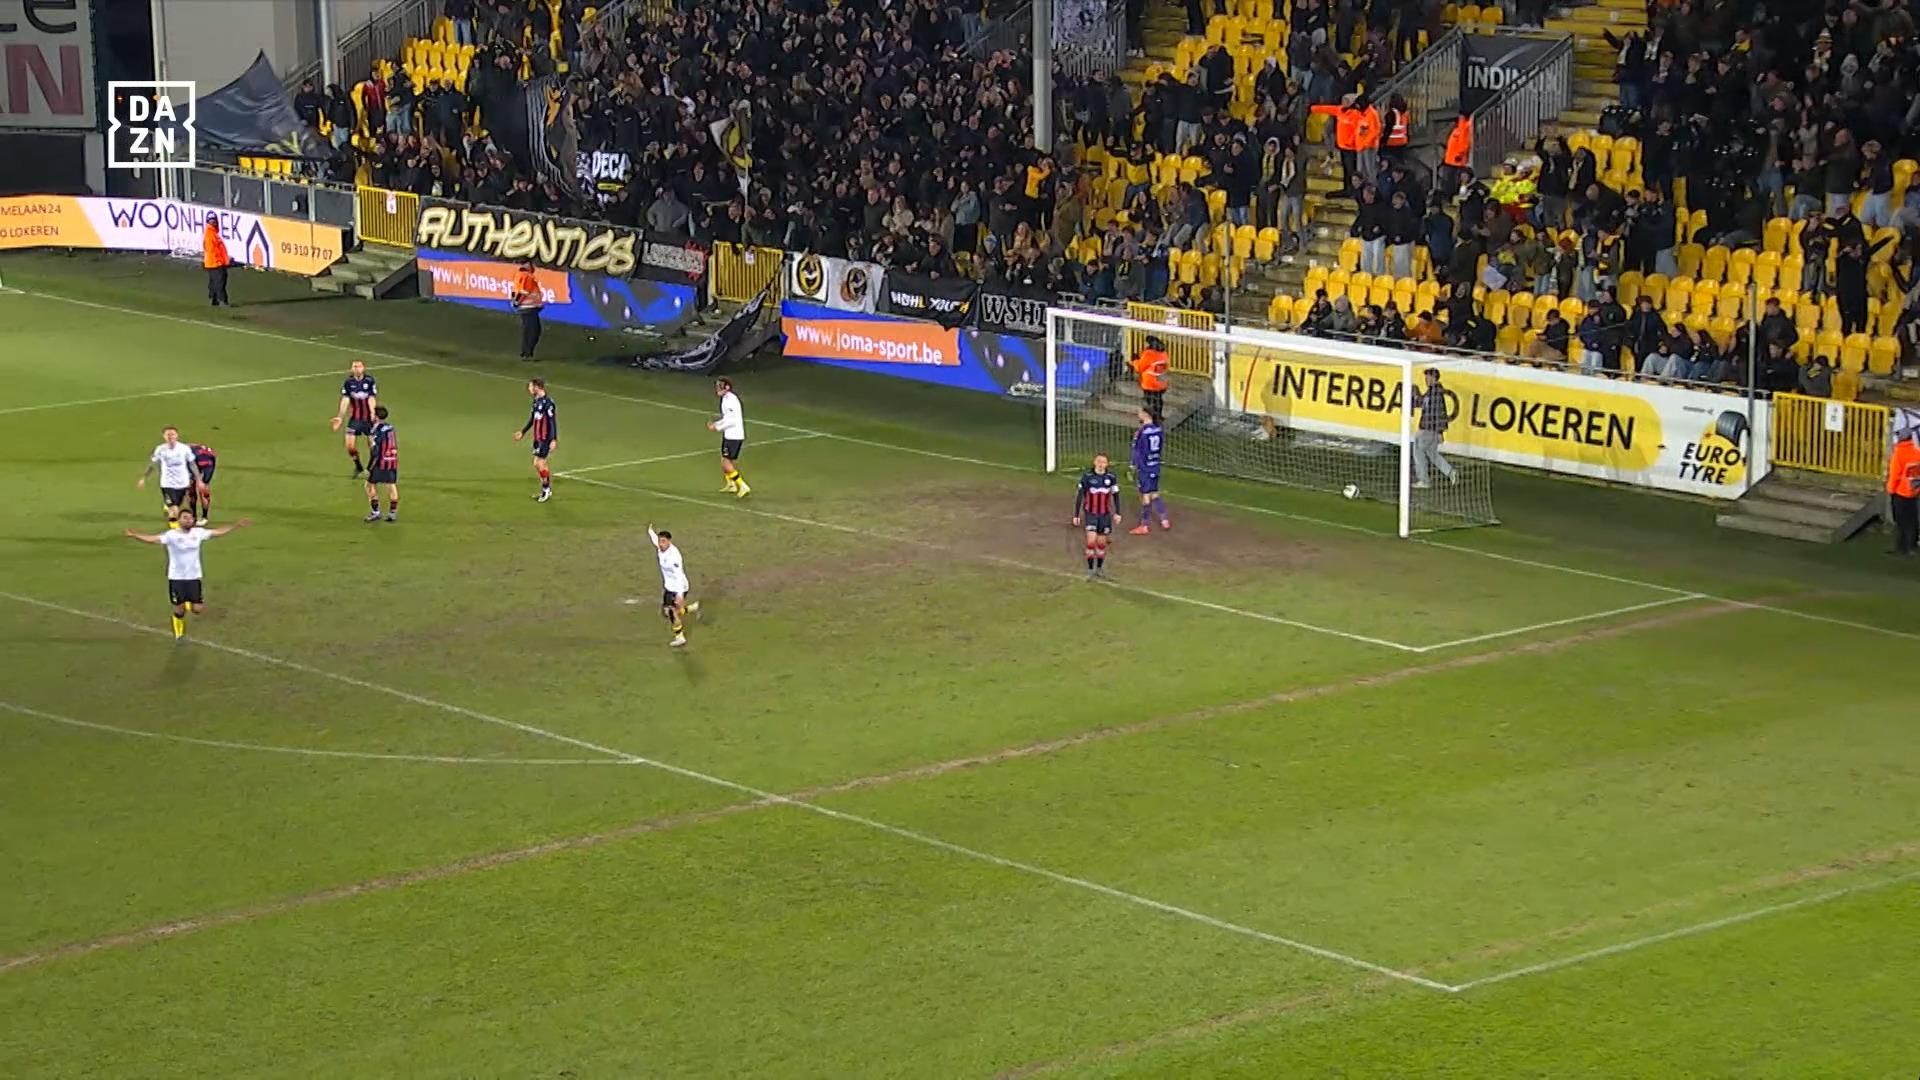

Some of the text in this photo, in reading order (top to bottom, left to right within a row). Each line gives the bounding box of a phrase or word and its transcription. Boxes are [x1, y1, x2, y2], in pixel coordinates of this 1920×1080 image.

[0, 44, 84, 116] N
[10, 225, 59, 238] LOKEREN
[107, 201, 242, 241] WOONHEK
[795, 325, 943, 365] www.joma-sport.be
[1271, 363, 1635, 450] INTERBAD LOKEREN
[1679, 461, 1728, 485] TYRE
[1682, 442, 1741, 466] EURO
